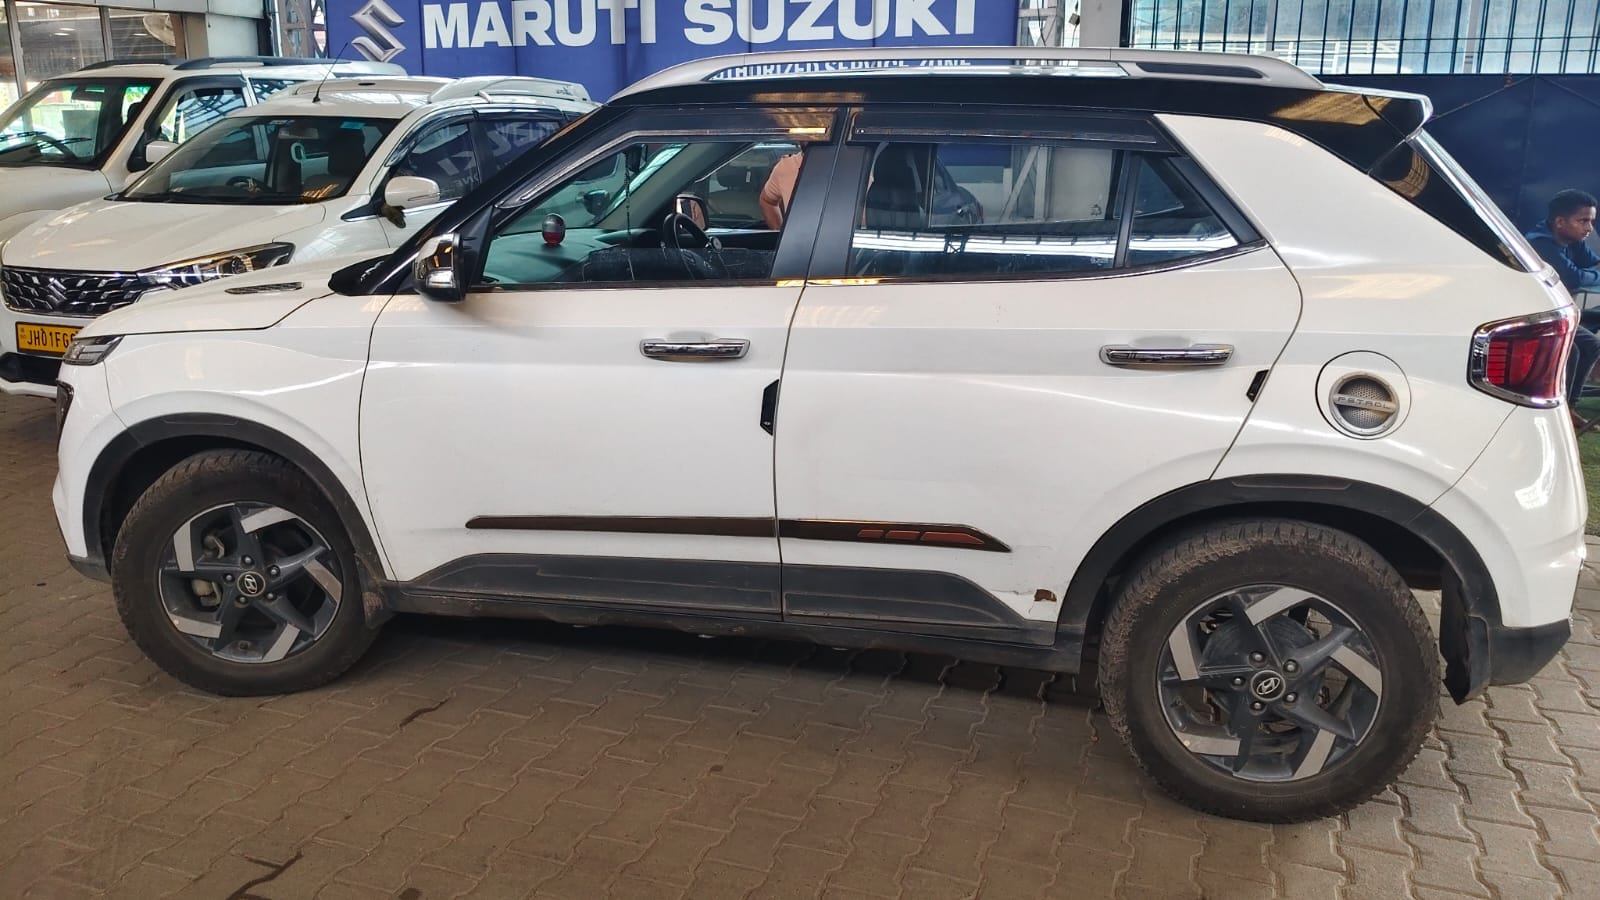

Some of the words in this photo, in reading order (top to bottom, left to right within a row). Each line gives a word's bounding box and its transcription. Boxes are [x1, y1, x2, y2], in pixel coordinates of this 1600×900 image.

[423, 0, 656, 49] MARUTI
[683, 0, 976, 46] SUZUKI
[710, 63, 819, 80] THORIZED
[1337, 396, 1391, 410] PETROL
